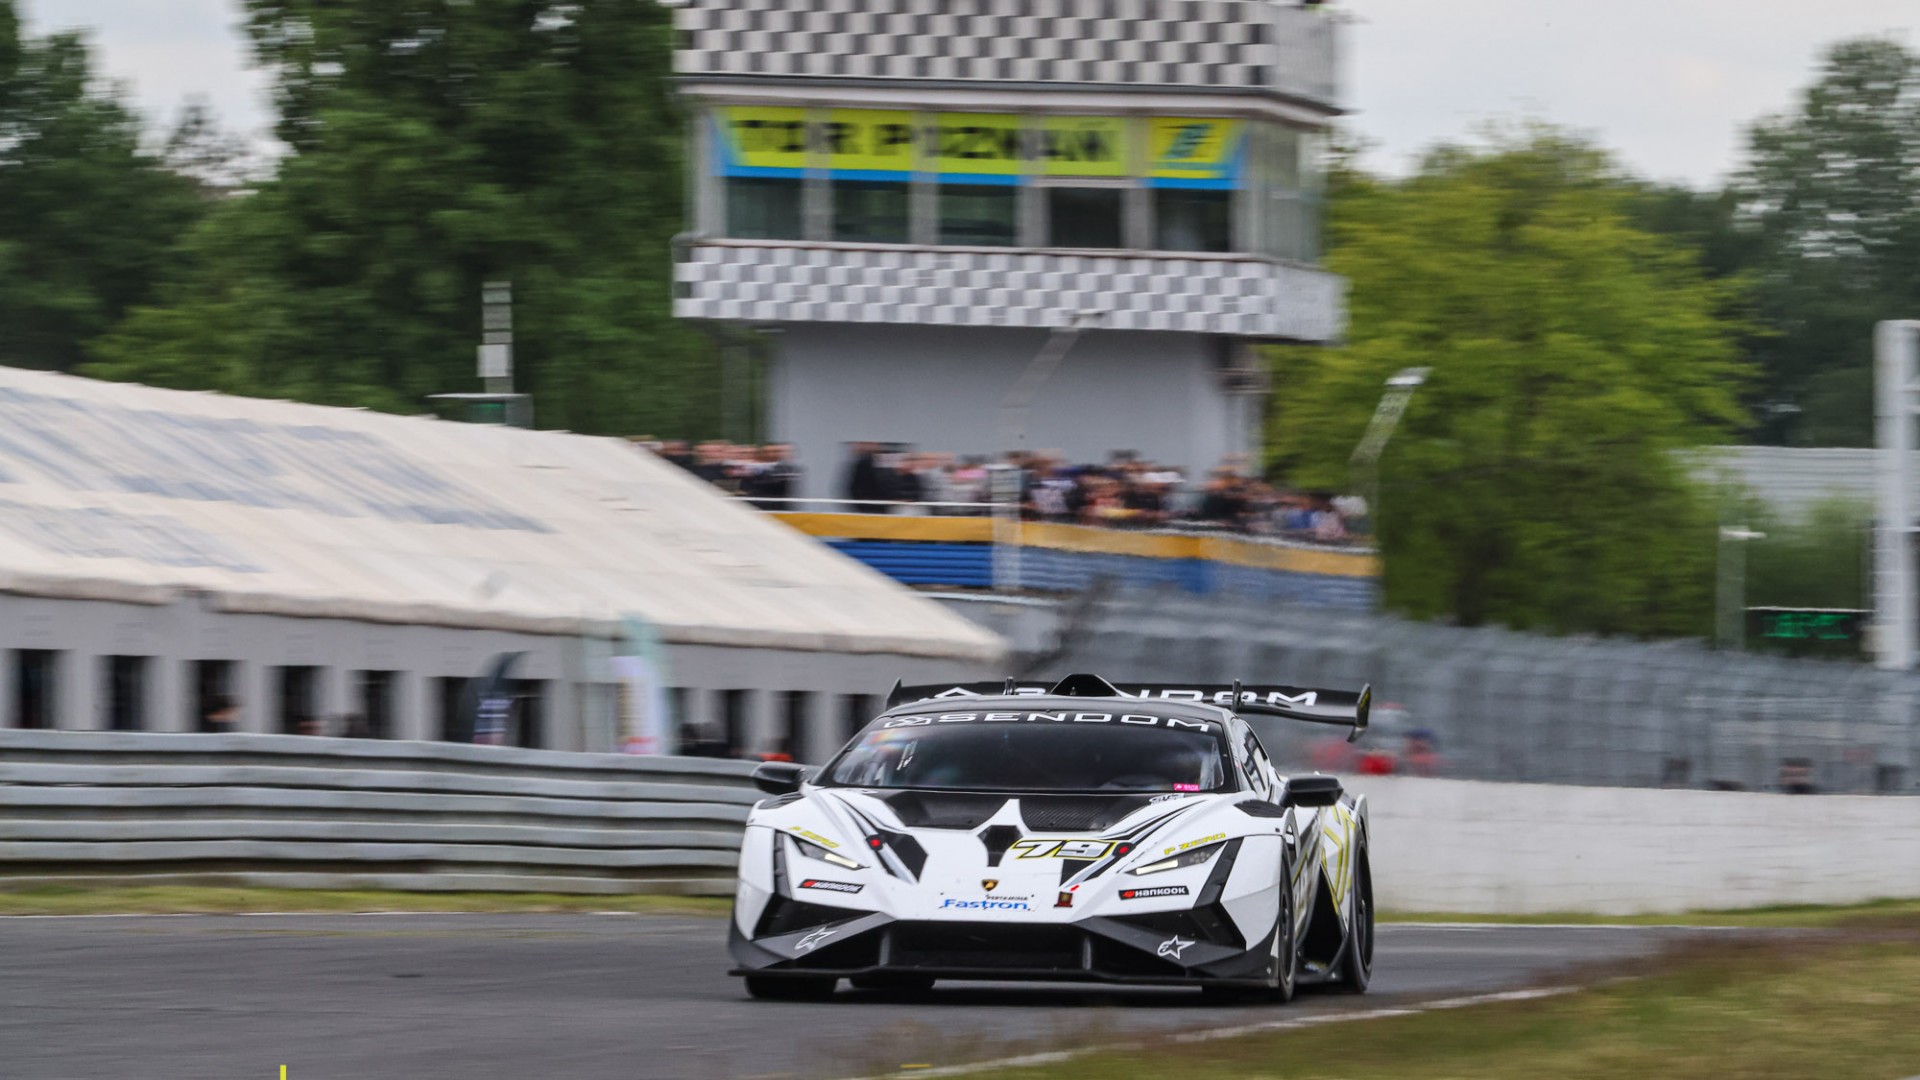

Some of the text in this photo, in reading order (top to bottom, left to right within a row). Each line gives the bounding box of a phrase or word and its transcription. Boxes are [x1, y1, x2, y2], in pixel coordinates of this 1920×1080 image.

[938, 712, 1210, 733] SENDOM
[1010, 839, 1118, 861] 79
[944, 898, 1028, 910] Fastron
